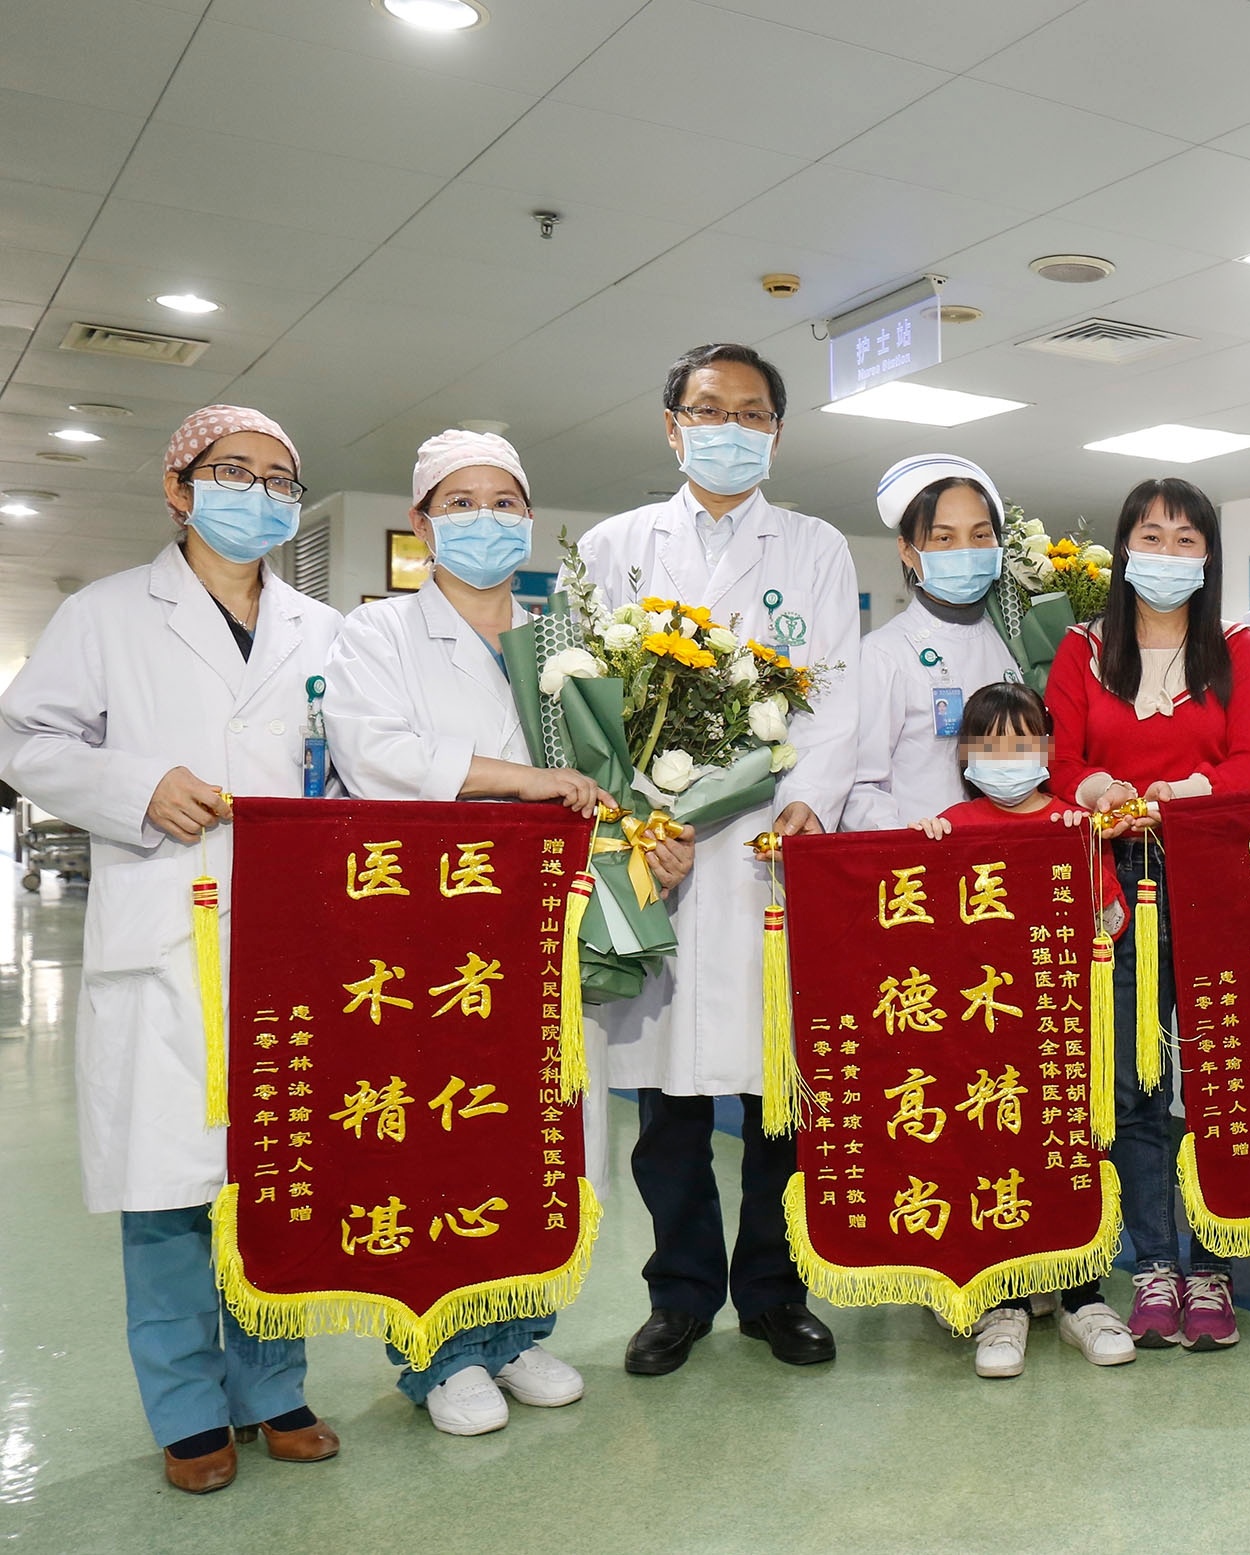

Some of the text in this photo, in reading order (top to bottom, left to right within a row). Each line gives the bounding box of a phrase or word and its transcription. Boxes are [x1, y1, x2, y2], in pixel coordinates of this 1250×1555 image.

[856, 318, 912, 366] 护士站
[252, 1009, 280, 1204] 二零二零年十二月
[328, 839, 414, 1256] 医术精湛
[427, 839, 509, 1243] 医者仁心
[810, 1018, 838, 1206] 二零二零年十二月
[872, 863, 952, 1241] 医德高尚
[953, 861, 1033, 1232] 医术精湛
[1029, 924, 1065, 1170] 孙强医生及全体医护人员
[1193, 976, 1222, 1139] 二零二零年十二月
